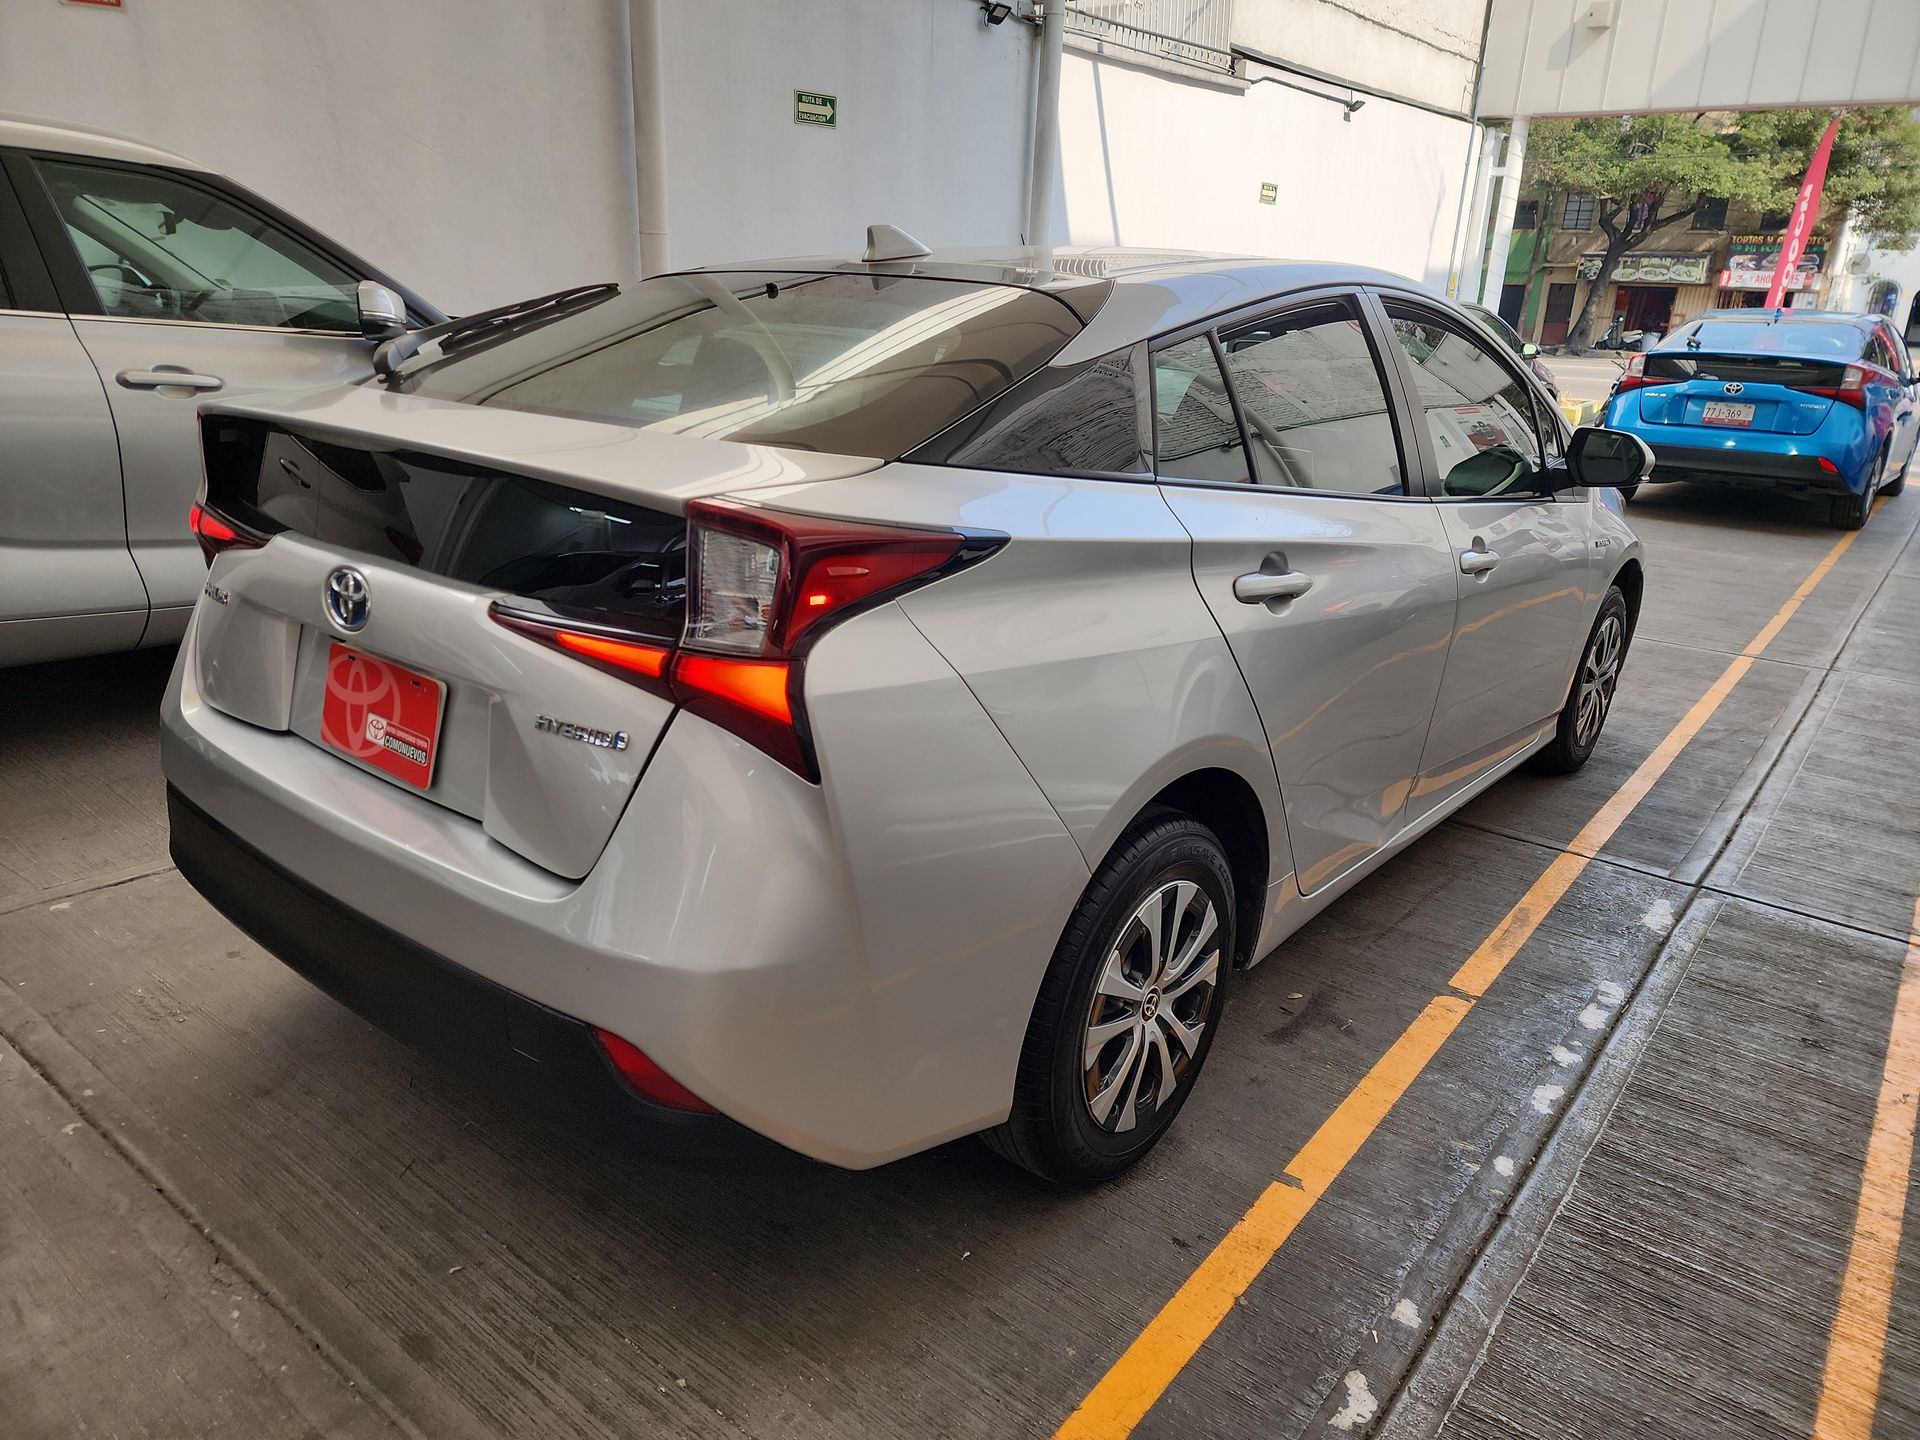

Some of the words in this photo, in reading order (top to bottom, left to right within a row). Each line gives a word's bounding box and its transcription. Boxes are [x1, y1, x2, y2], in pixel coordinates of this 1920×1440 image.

[801, 95, 815, 104] RUTA
[1732, 235, 1764, 244] TORTAS
[1767, 235, 1774, 244] Y
[1705, 407, 1742, 419] 77J-369
[534, 713, 612, 748] HYBRID
[384, 735, 427, 764] COMONUEVOS
